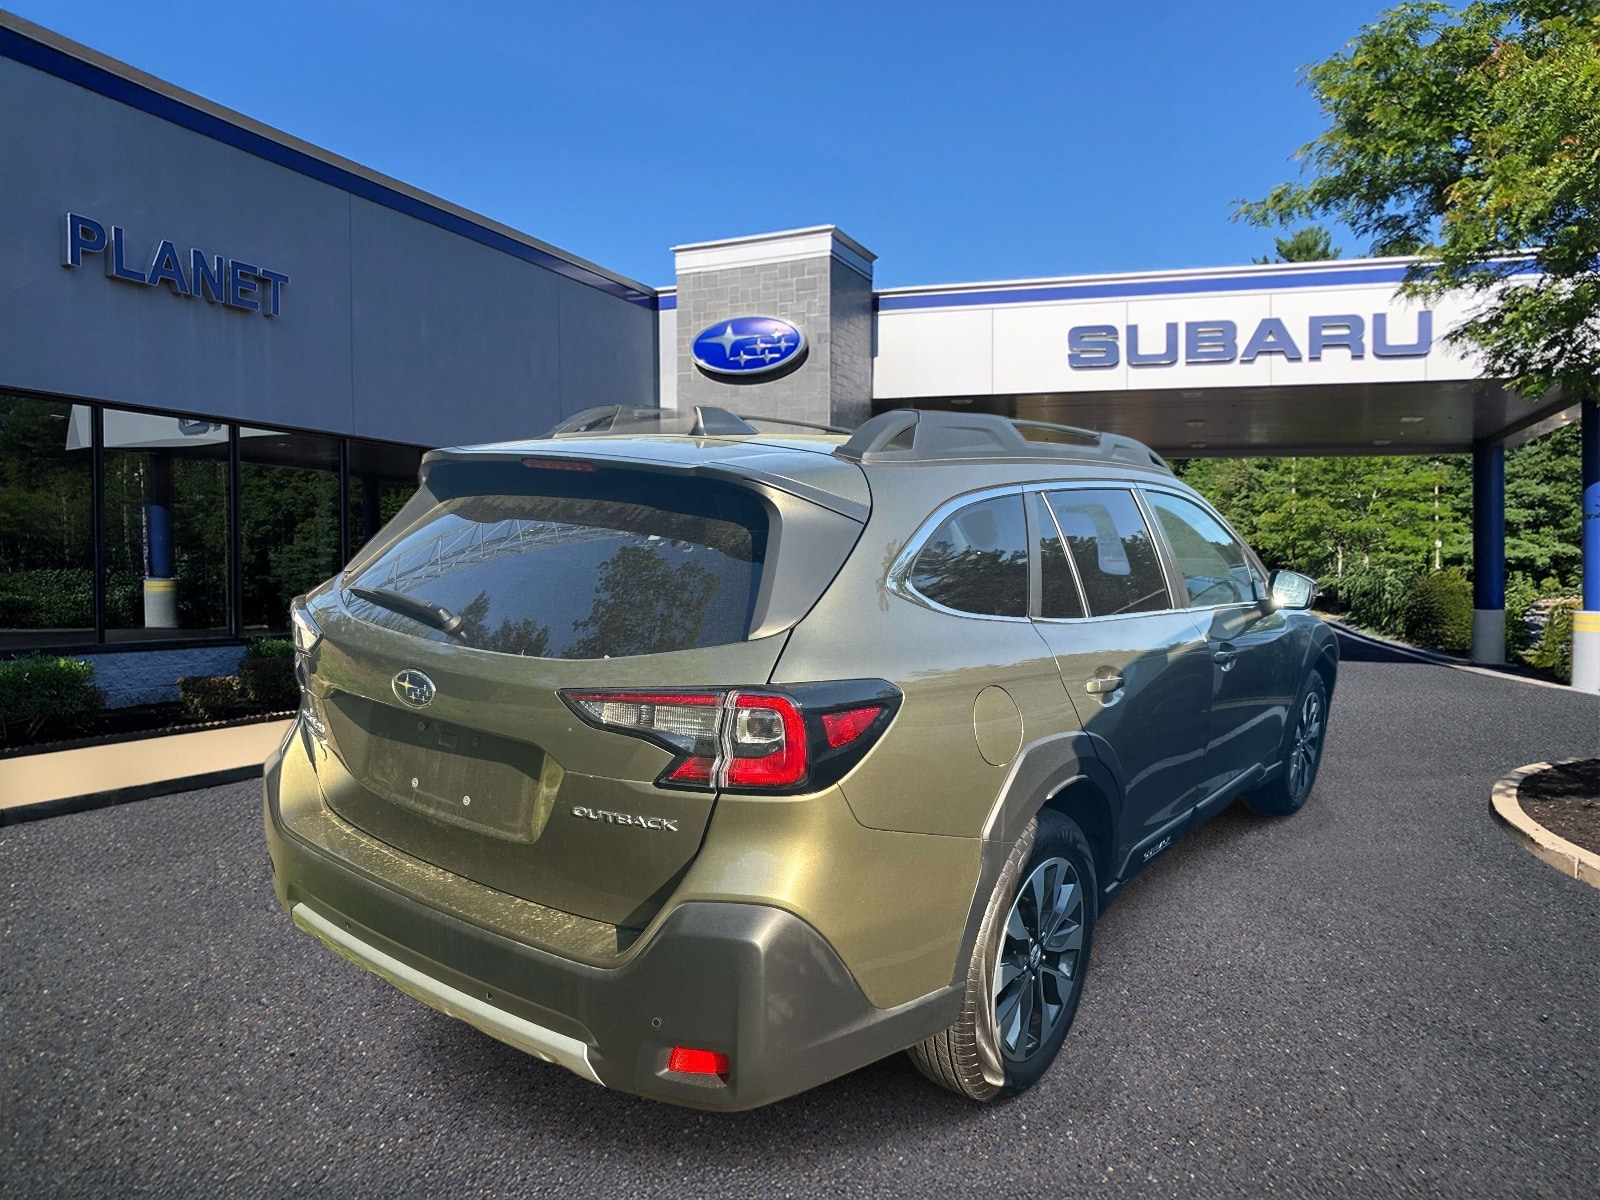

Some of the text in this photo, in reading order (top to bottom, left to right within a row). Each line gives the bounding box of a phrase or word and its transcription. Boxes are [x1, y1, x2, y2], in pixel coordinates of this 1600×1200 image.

[64, 211, 290, 317] PLANET
[1067, 310, 1433, 369] SUBARU
[571, 805, 678, 832] OUTBACK
